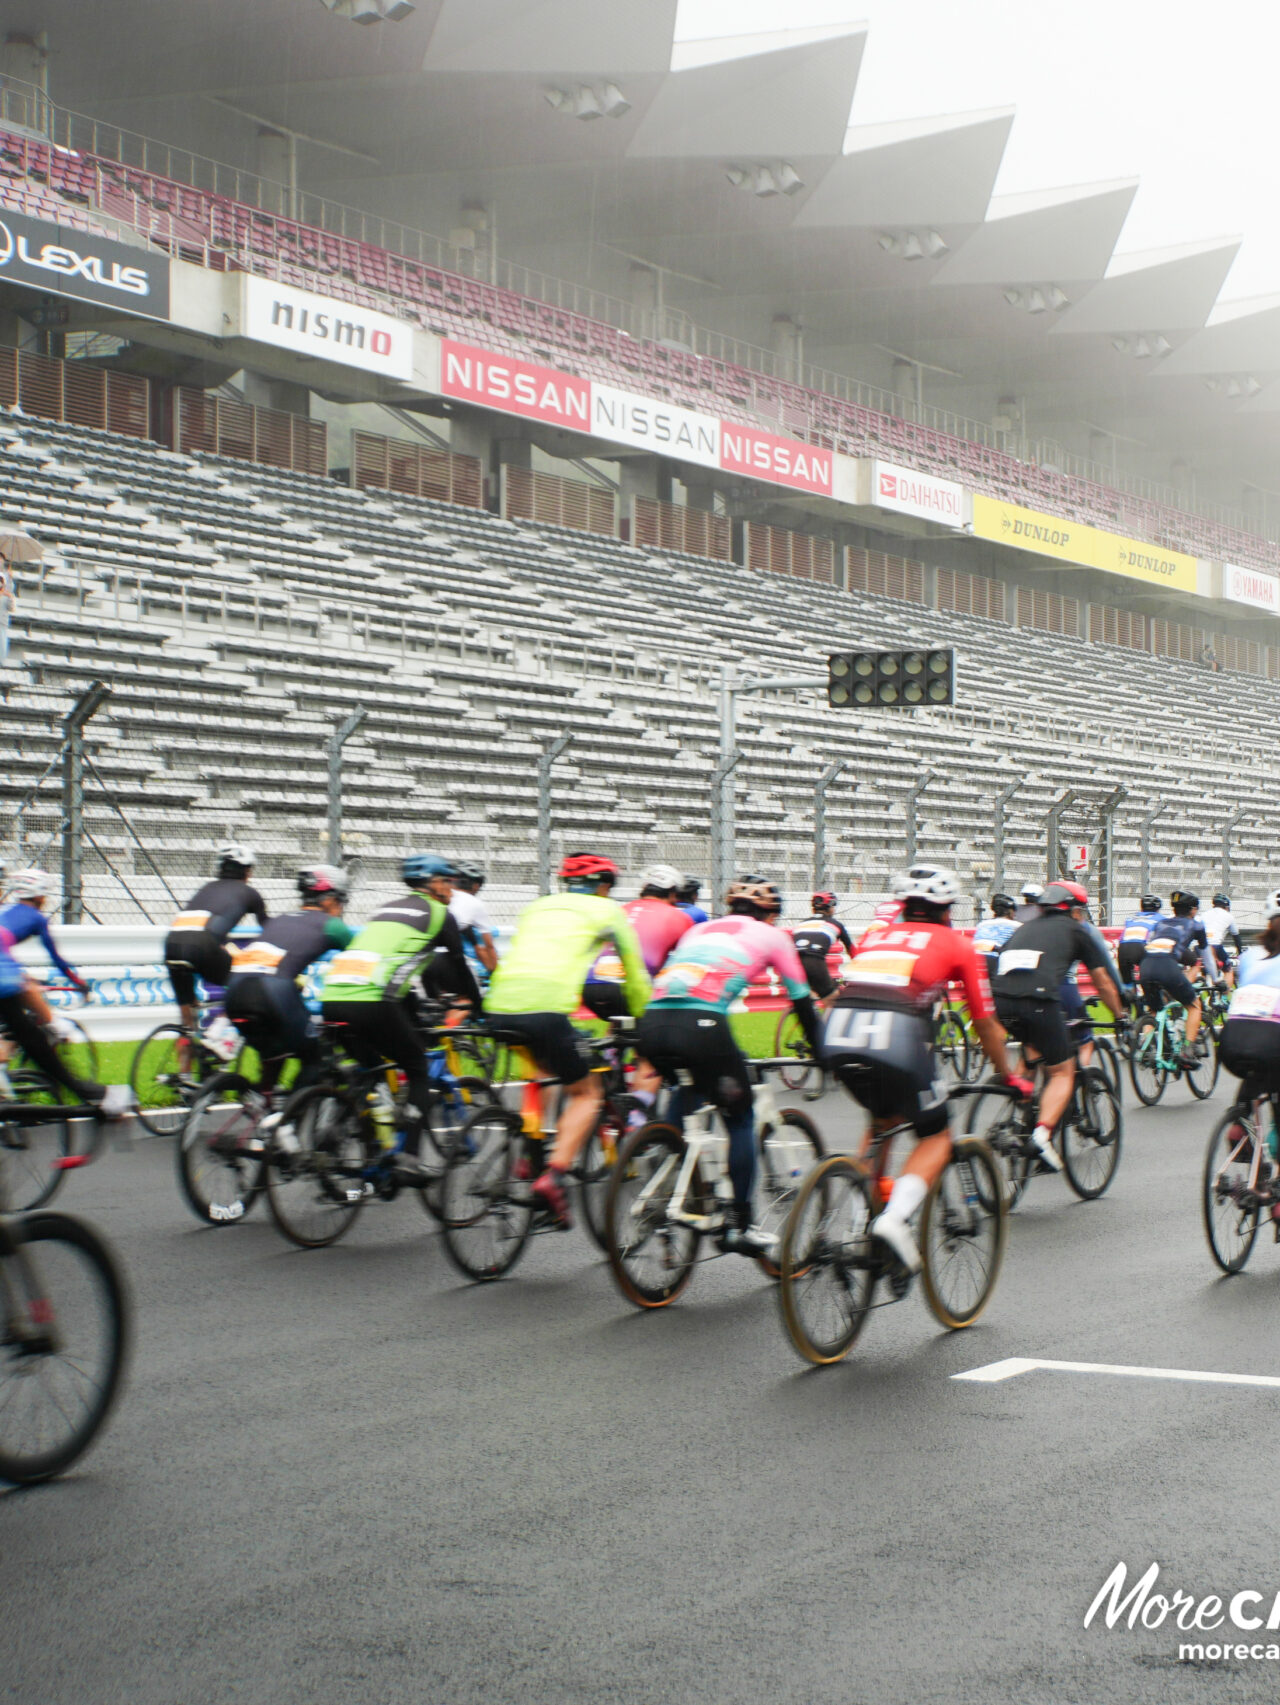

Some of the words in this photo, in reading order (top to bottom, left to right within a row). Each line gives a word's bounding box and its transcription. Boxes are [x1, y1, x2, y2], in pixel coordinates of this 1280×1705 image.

[17, 234, 150, 296] LEXUS
[271, 300, 392, 356] nismo
[447, 352, 588, 421] NISSAN
[596, 396, 716, 455] NISSAN
[723, 433, 829, 486] NISSAN
[900, 479, 960, 515] DAIHATSU
[1013, 520, 1070, 547] DUNLOP
[1128, 552, 1176, 576] DUNLOP
[1242, 575, 1273, 604] YAMAHA
